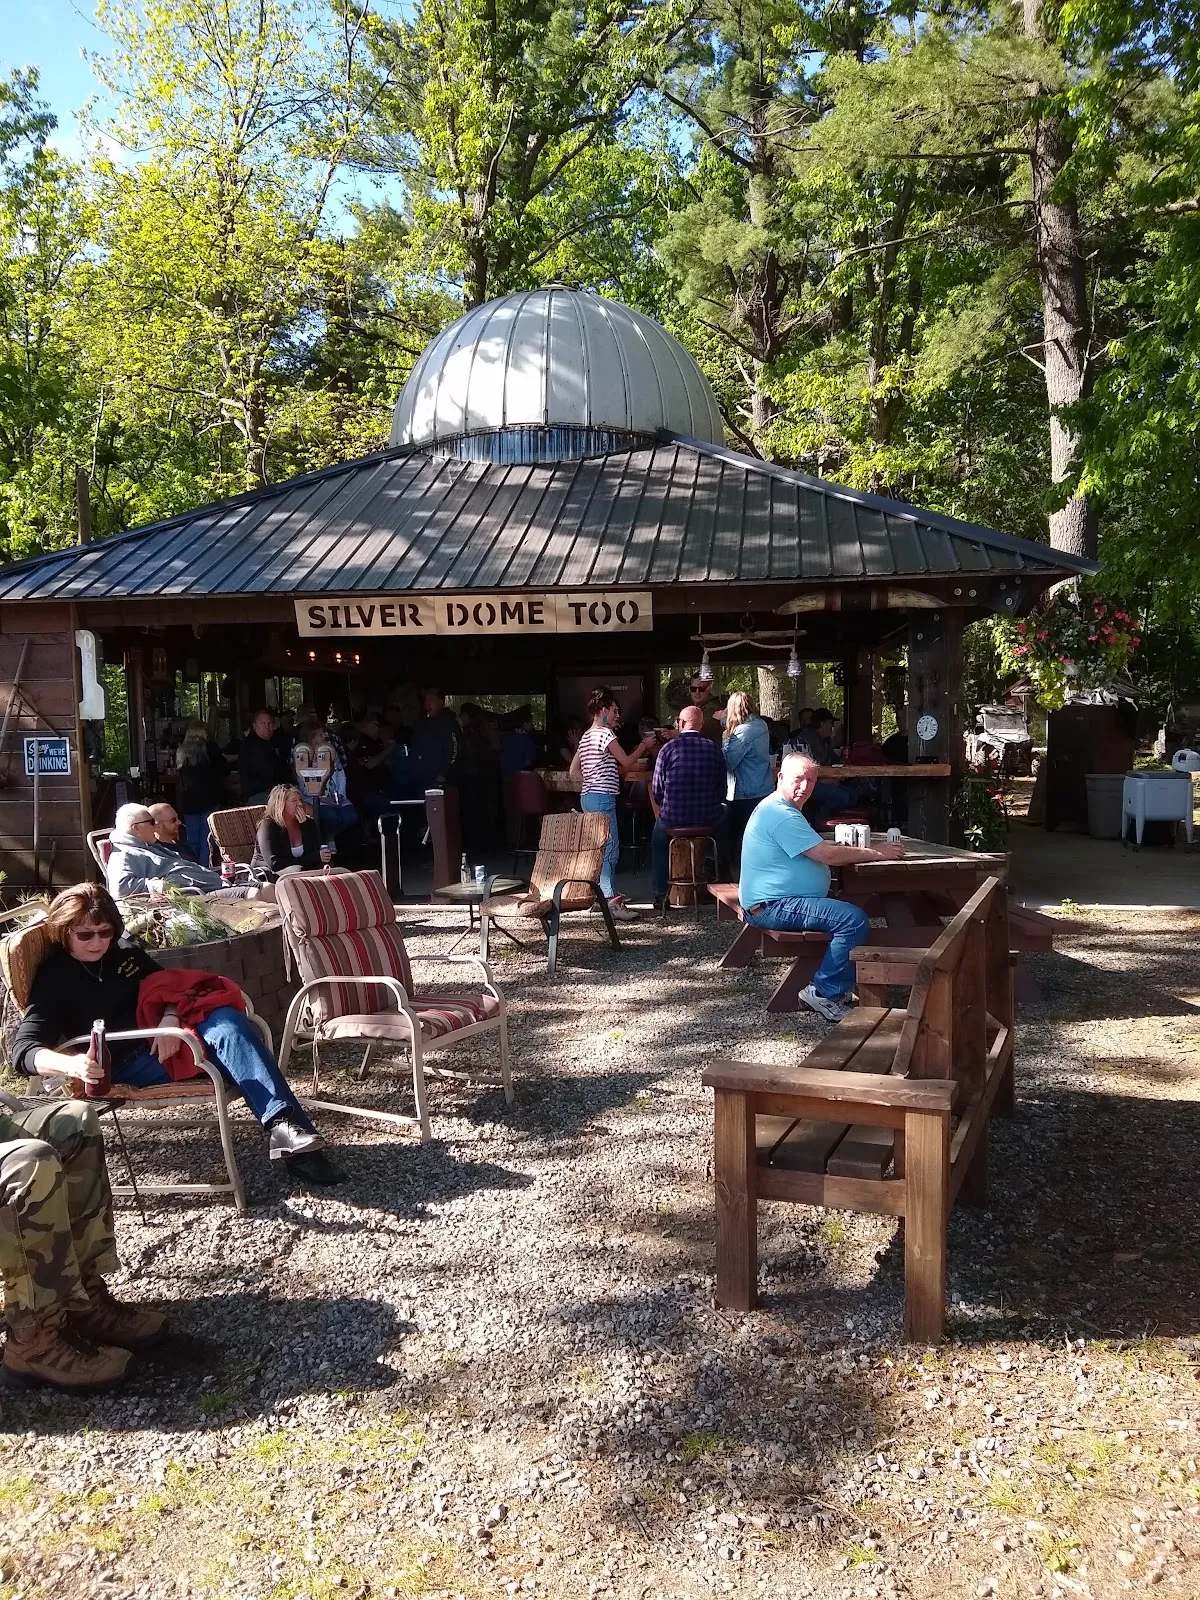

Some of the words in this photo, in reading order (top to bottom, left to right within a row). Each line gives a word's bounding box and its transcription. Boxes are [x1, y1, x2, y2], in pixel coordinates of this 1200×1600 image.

[308, 603, 424, 629] SILVER
[446, 601, 545, 627] DOME
[568, 599, 640, 626] TOO
[28, 757, 67, 770] DINKING
